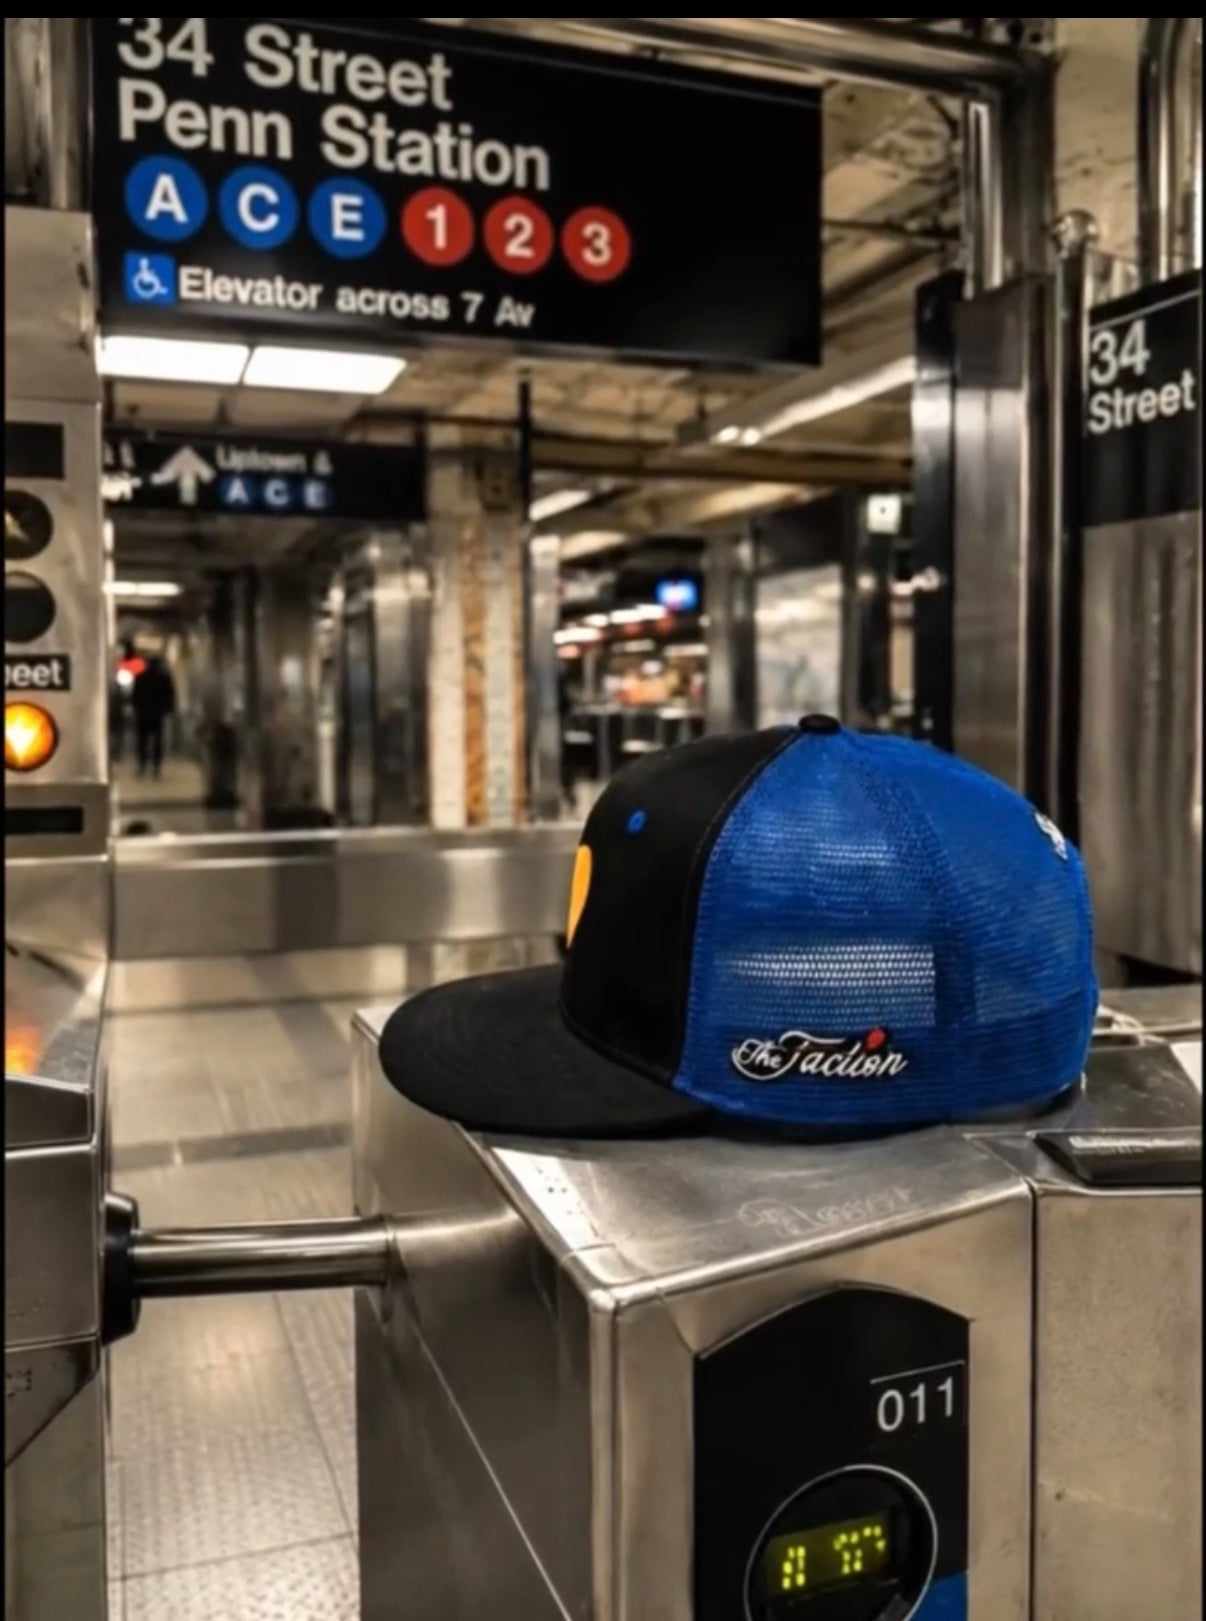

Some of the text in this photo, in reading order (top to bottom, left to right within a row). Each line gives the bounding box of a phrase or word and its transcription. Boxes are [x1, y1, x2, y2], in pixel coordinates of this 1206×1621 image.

[118, 18, 453, 110] 34 Street
[118, 78, 551, 190] Penn Station
[145, 173, 613, 265] A C E 1 2 3
[178, 265, 535, 328] Elevator across 7 Av
[1090, 319, 1150, 386] 34
[1088, 368, 1196, 433] Street
[226, 477, 327, 509] A C E
[777, 1029, 908, 1080] Faction
[877, 1376, 955, 1432] 011
